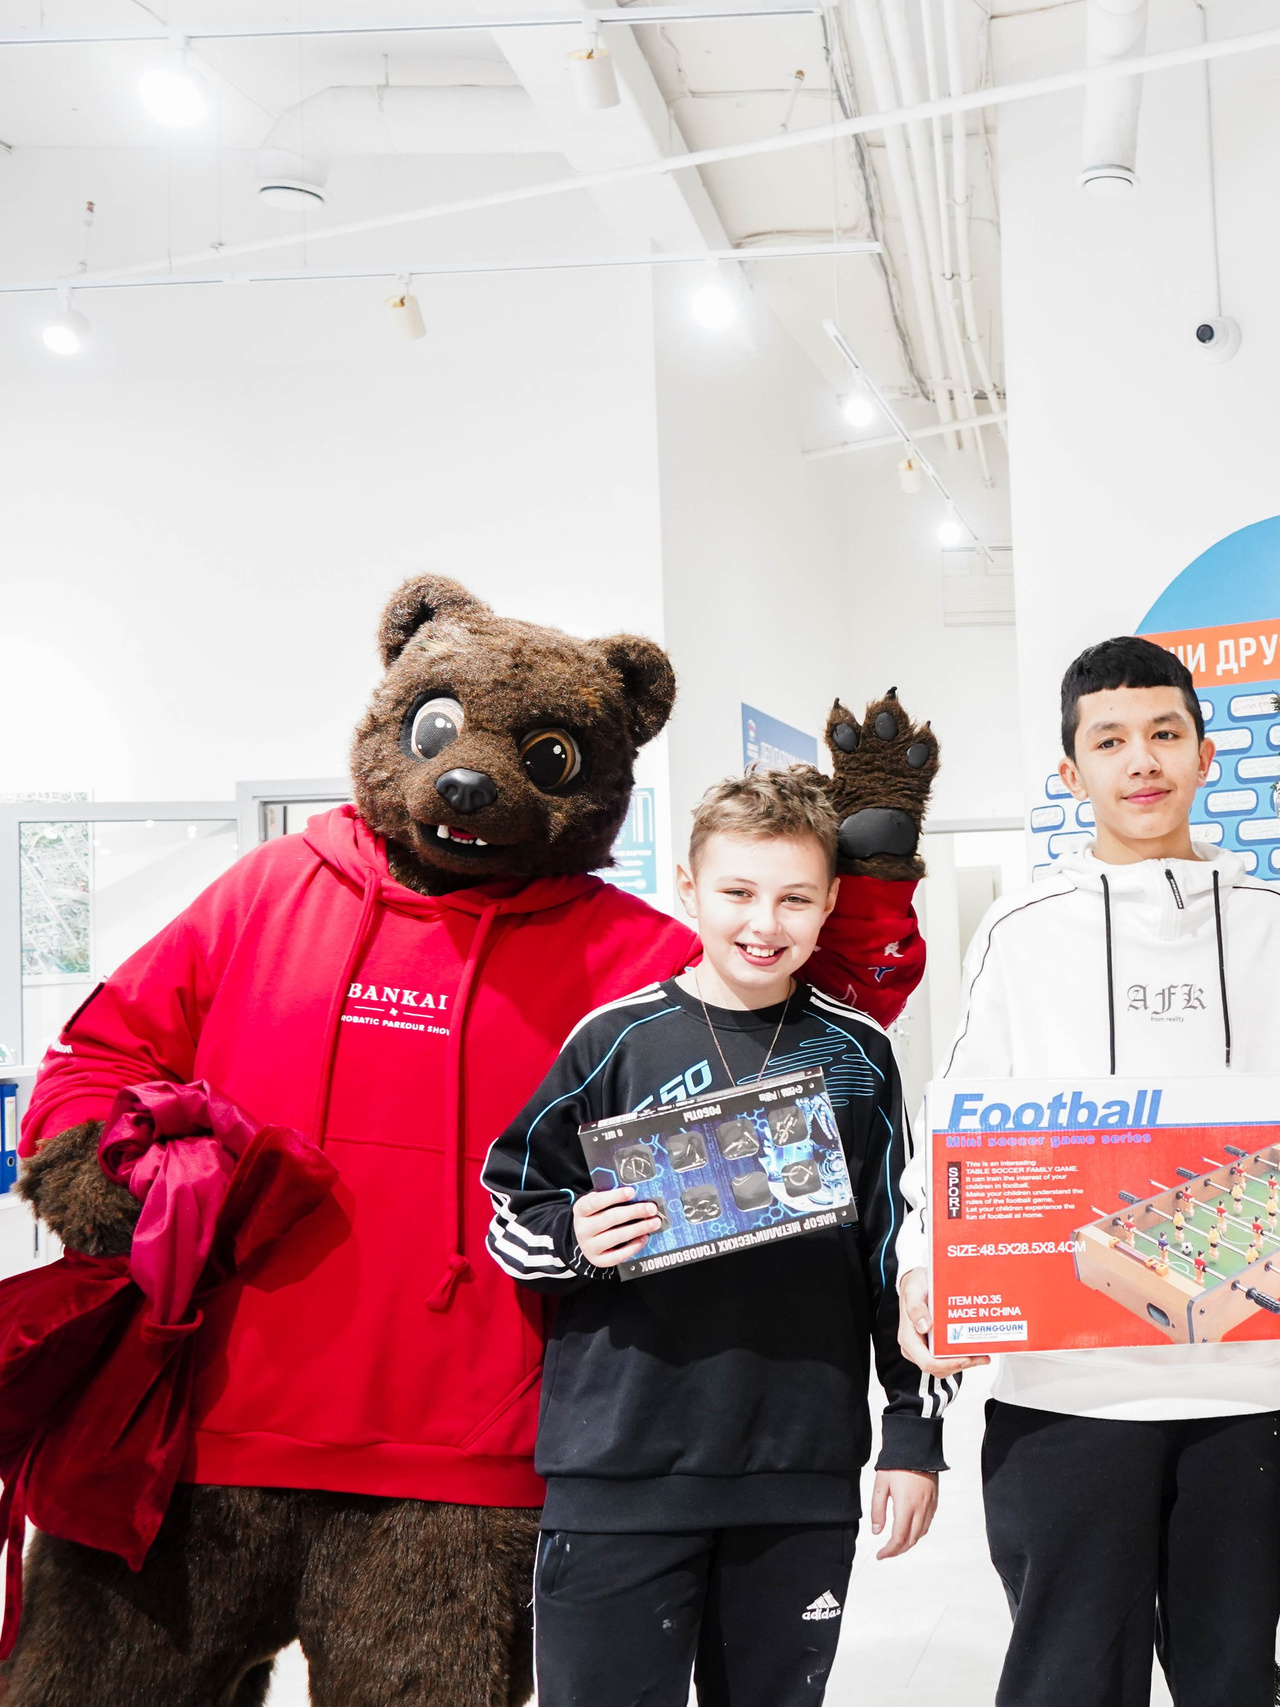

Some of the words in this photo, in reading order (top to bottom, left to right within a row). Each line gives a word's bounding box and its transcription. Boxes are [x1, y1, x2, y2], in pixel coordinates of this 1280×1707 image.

[347, 982, 449, 1010] BANKAI
[382, 1019, 424, 1032] PARKOUR
[427, 1026, 450, 1036] SHO
[947, 1089, 1163, 1130] Football
[946, 1134, 982, 1148] Mini
[988, 1134, 1045, 1147] soccer
[1050, 1133, 1095, 1148] game
[1101, 1131, 1151, 1144] series
[965, 1160, 981, 1168] This
[1000, 1159, 1036, 1167] interesting
[948, 1167, 960, 1217] SPORT
[1003, 1189, 1031, 1197] children
[1032, 1188, 1071, 1196] understand
[979, 1206, 994, 1214] your
[804, 1212, 838, 1231] НАБОР
[718, 1221, 802, 1252] МЕТАЛЛИЧЕСКИХ
[947, 1240, 1086, 1257] SIZE:48.5X28.5X8.4CM
[639, 1243, 716, 1273] ГОЛОВОЛОМОК
[947, 1296, 971, 1306] ITEM
[973, 1294, 1002, 1305] NO.35
[947, 1308, 977, 1318] MADE
[979, 1307, 989, 1317] IN
[990, 1306, 1022, 1317] CHINA
[968, 1324, 1024, 1333] HUANGGUAN
[802, 1607, 841, 1621] adidas
